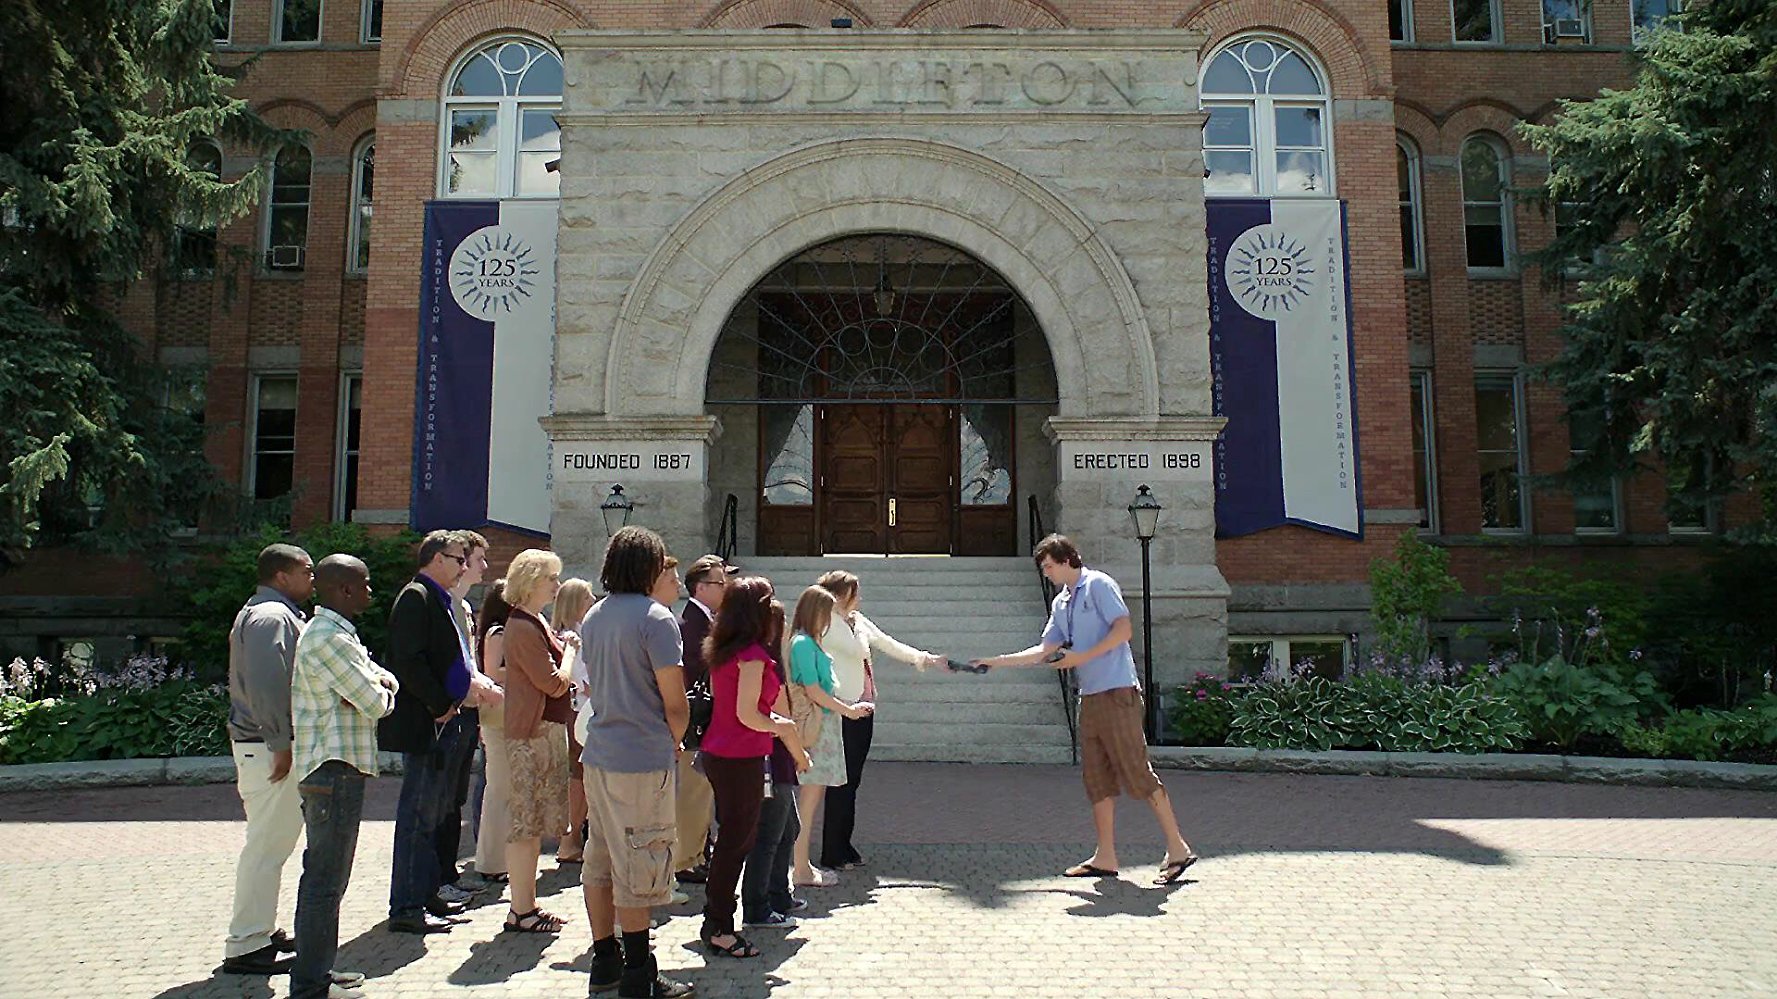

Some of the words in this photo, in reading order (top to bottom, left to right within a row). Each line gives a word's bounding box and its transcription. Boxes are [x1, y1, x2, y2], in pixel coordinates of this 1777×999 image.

[624, 60, 1143, 106] MIDDLETON
[432, 239, 443, 324] TRADITION
[478, 259, 516, 277] 125
[1209, 237, 1220, 322] TRADITION
[1254, 257, 1292, 276] 125
[1256, 277, 1292, 286] YEARS
[1327, 237, 1338, 322] TRADITION
[478, 279, 515, 288] YEARS
[424, 354, 438, 491] TRANSFORMATION
[1332, 353, 1347, 489] TRANSFORMATION
[564, 454, 640, 469] FOUNDED
[654, 454, 691, 469] 1887
[1074, 454, 1149, 469] ERECTED
[1163, 454, 1201, 468] 1898
